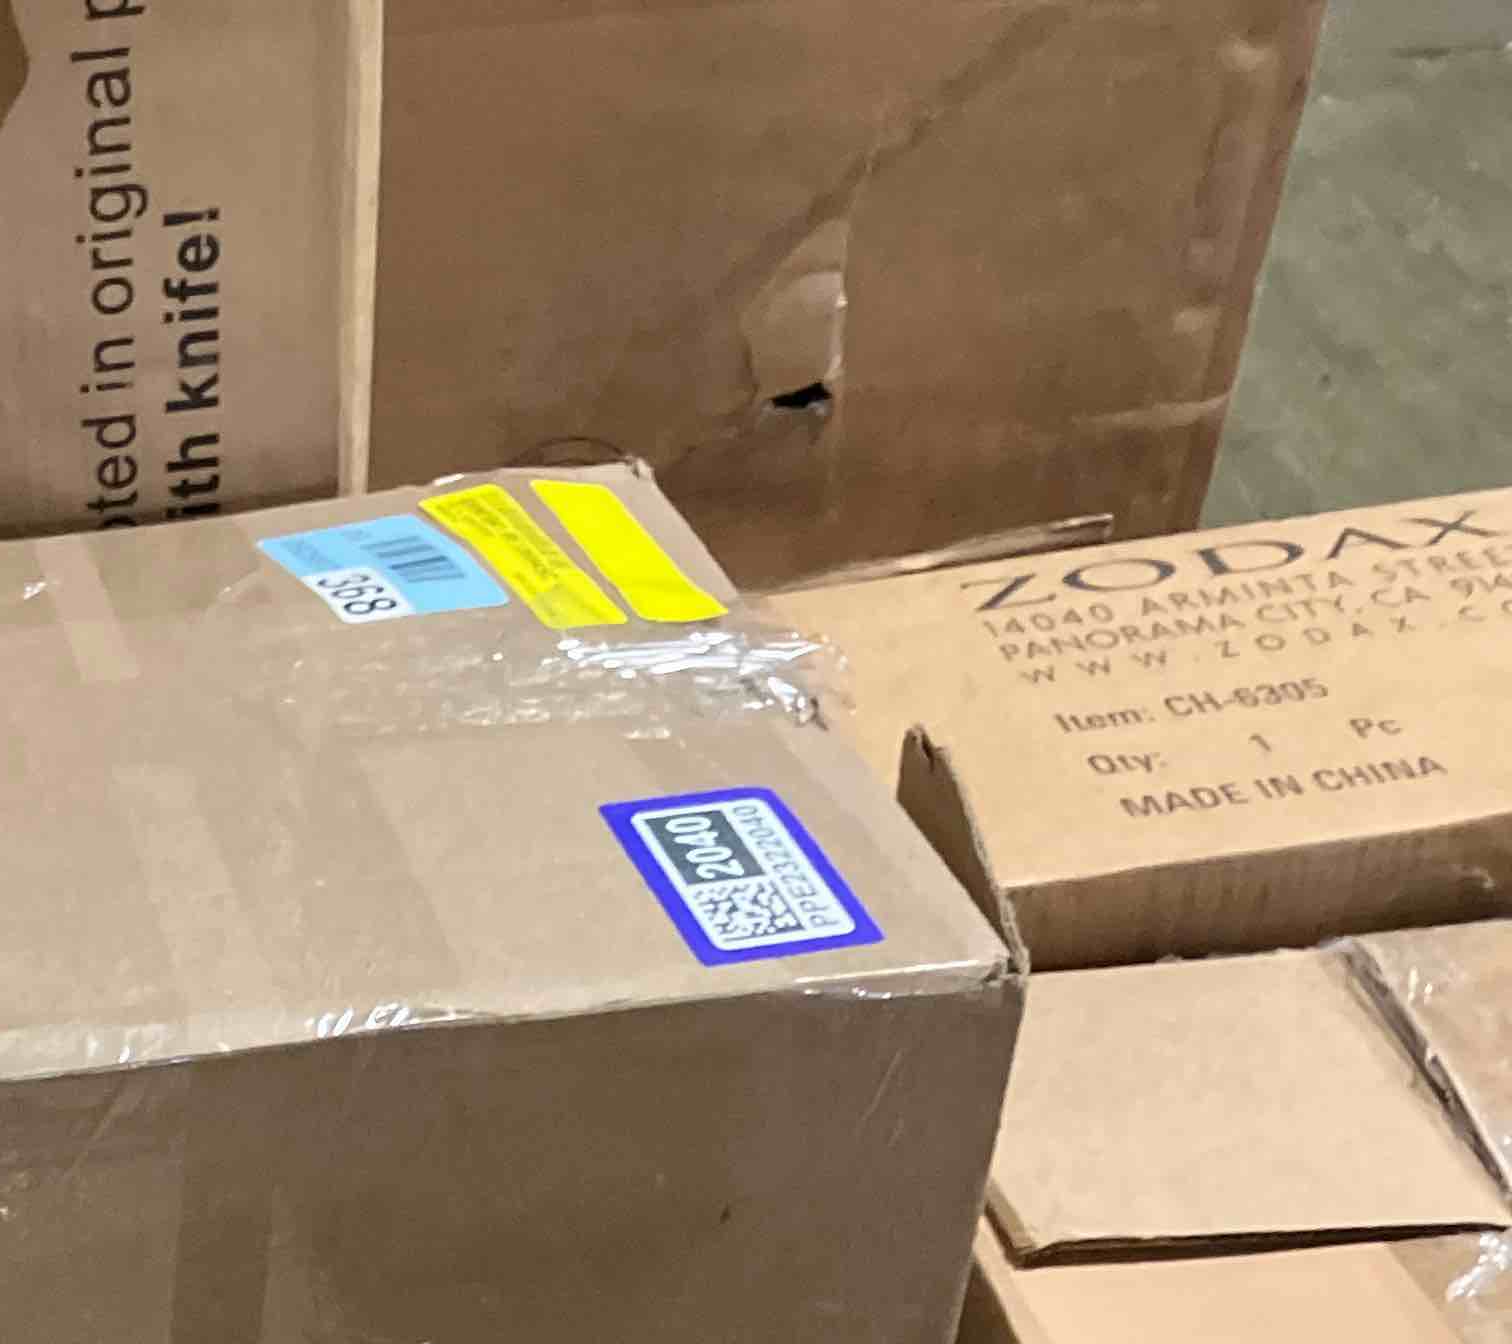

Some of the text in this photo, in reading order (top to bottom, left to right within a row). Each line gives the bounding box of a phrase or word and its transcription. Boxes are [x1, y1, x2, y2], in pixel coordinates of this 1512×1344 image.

[70, 47, 148, 315] original
[163, 207, 221, 413] knife!
[79, 335, 136, 394] in
[960, 509, 1508, 612] ZODAX
[983, 544, 1512, 638] 14040 ARMINTA STREE
[999, 612, 1246, 661] PANORAMA
[1054, 708, 1156, 734] Item:
[1087, 716, 1403, 777] Qty: 1 Pc
[1120, 755, 1449, 818] MADE IN CHINA
[664, 815, 745, 880] 2040
